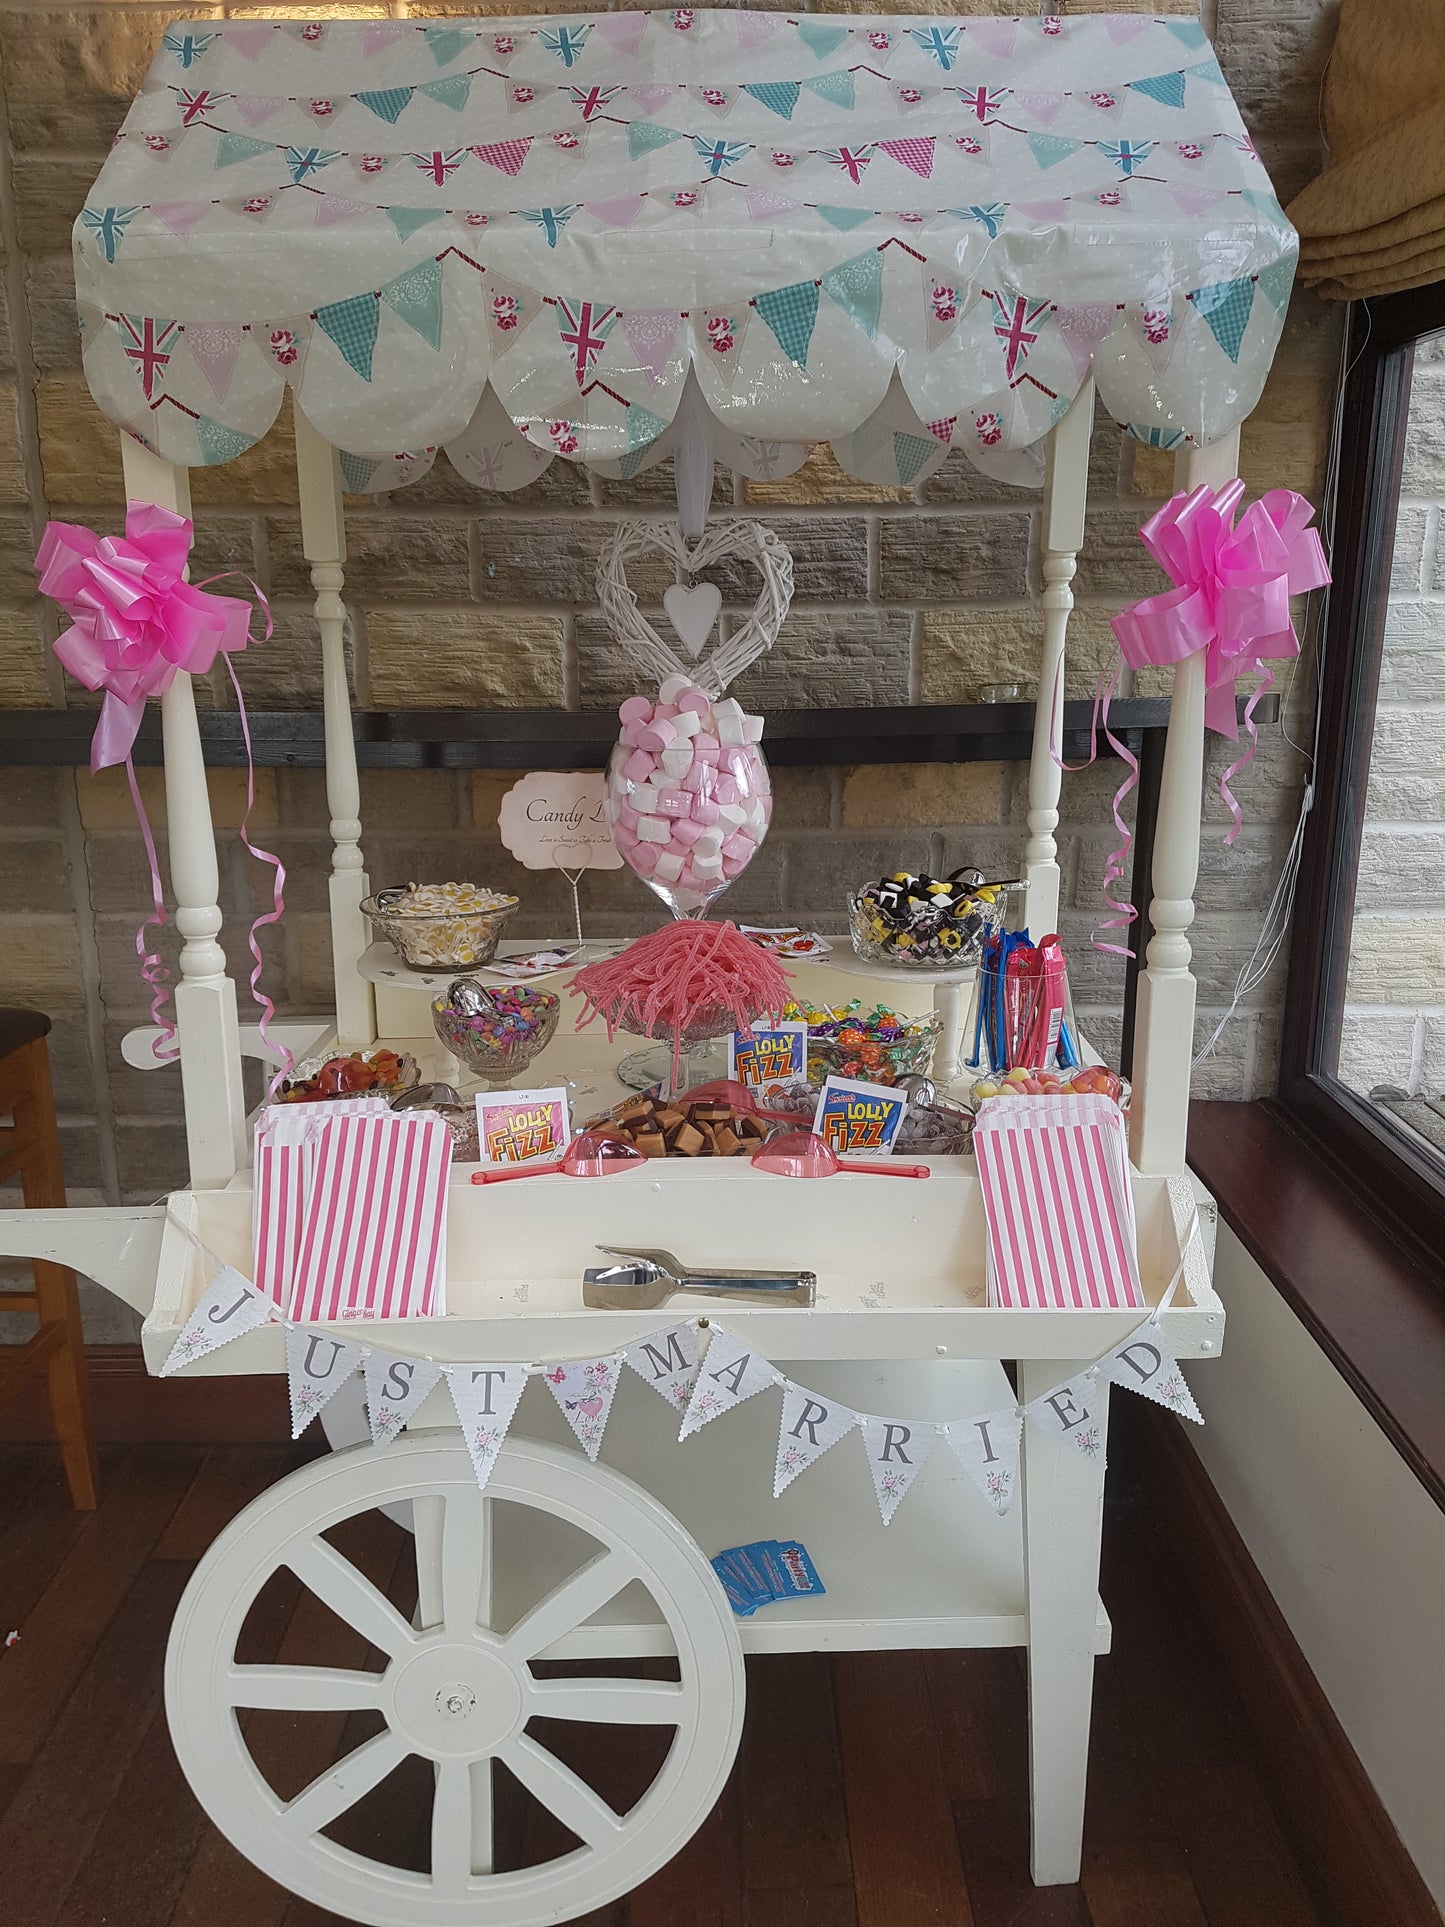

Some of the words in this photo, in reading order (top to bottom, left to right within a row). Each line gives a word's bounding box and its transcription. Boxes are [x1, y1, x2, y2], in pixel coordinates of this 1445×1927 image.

[526, 796, 587, 830] Candy
[754, 1034, 795, 1055] LOLLY
[508, 1104, 553, 1133] LOLLY
[847, 1101, 895, 1121] LOLLY
[208, 1288, 506, 1416] JUST
[638, 1331, 1163, 1465] MARRIED
